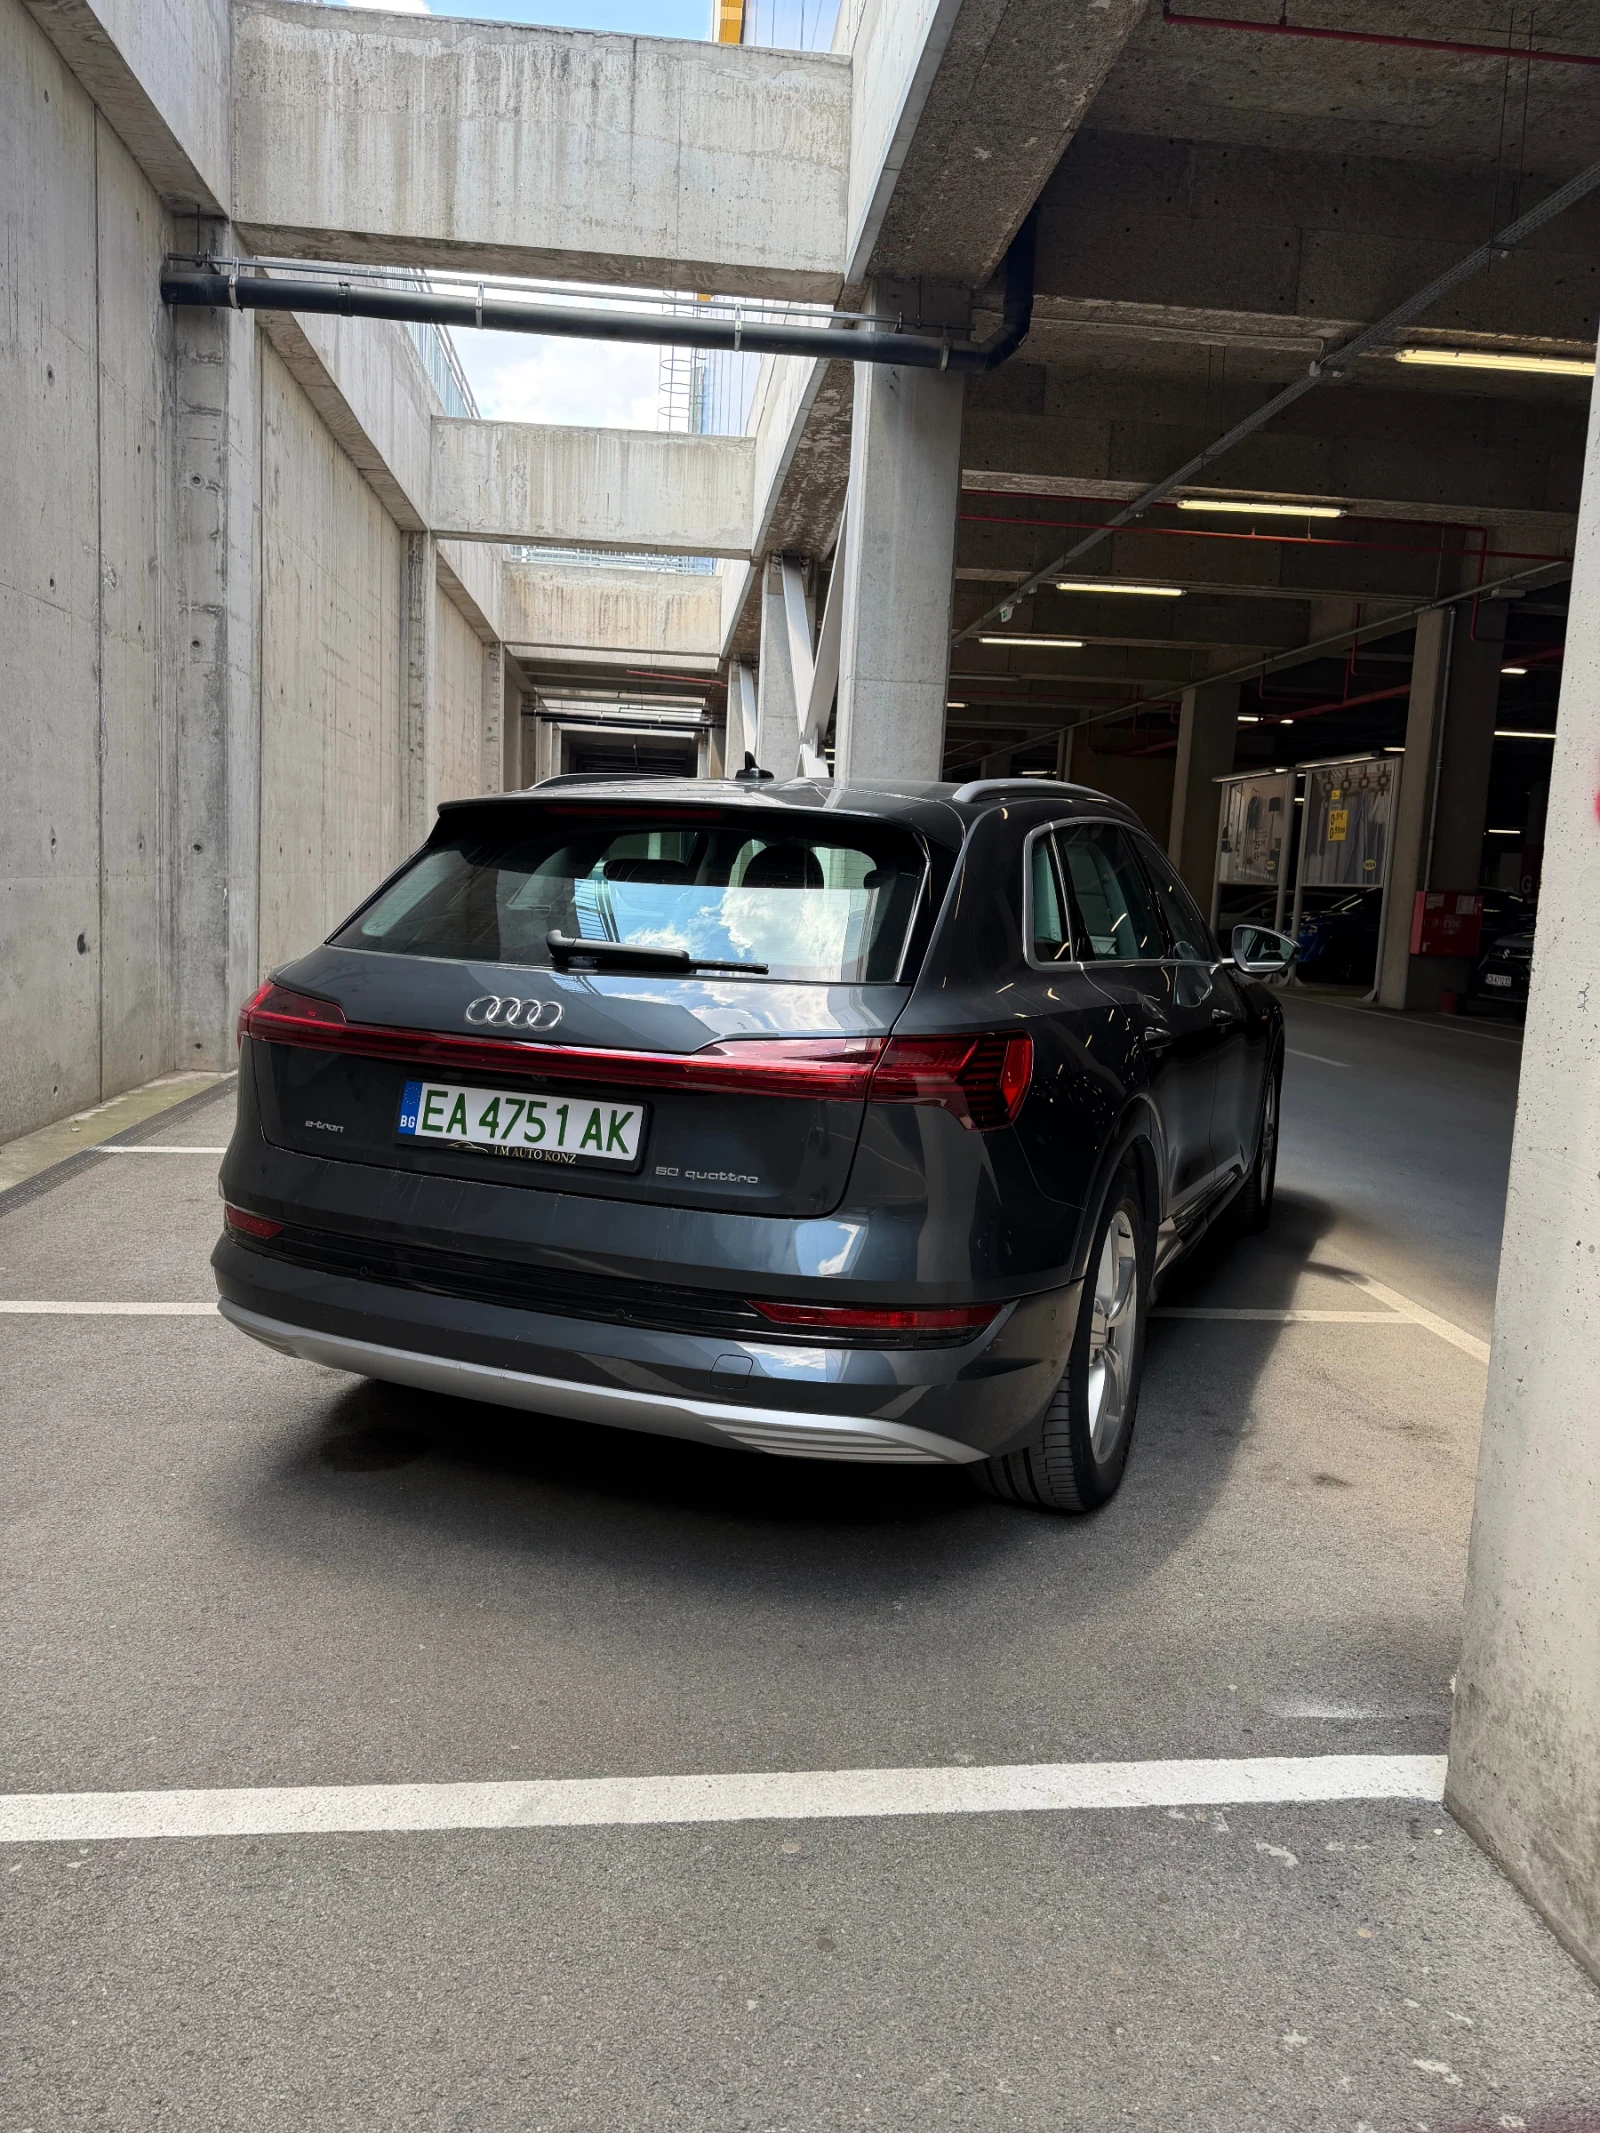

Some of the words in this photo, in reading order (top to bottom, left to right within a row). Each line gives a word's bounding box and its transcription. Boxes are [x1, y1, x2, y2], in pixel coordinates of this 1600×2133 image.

[305, 1120, 344, 1133] e-tron
[400, 1115, 416, 1129] BG
[421, 1090, 468, 1136] EA
[478, 1096, 570, 1147] 4751
[579, 1107, 635, 1154] AK
[511, 1147, 543, 1160] AUTO
[545, 1151, 577, 1164] KONZ
[685, 1170, 759, 1184] quattro
